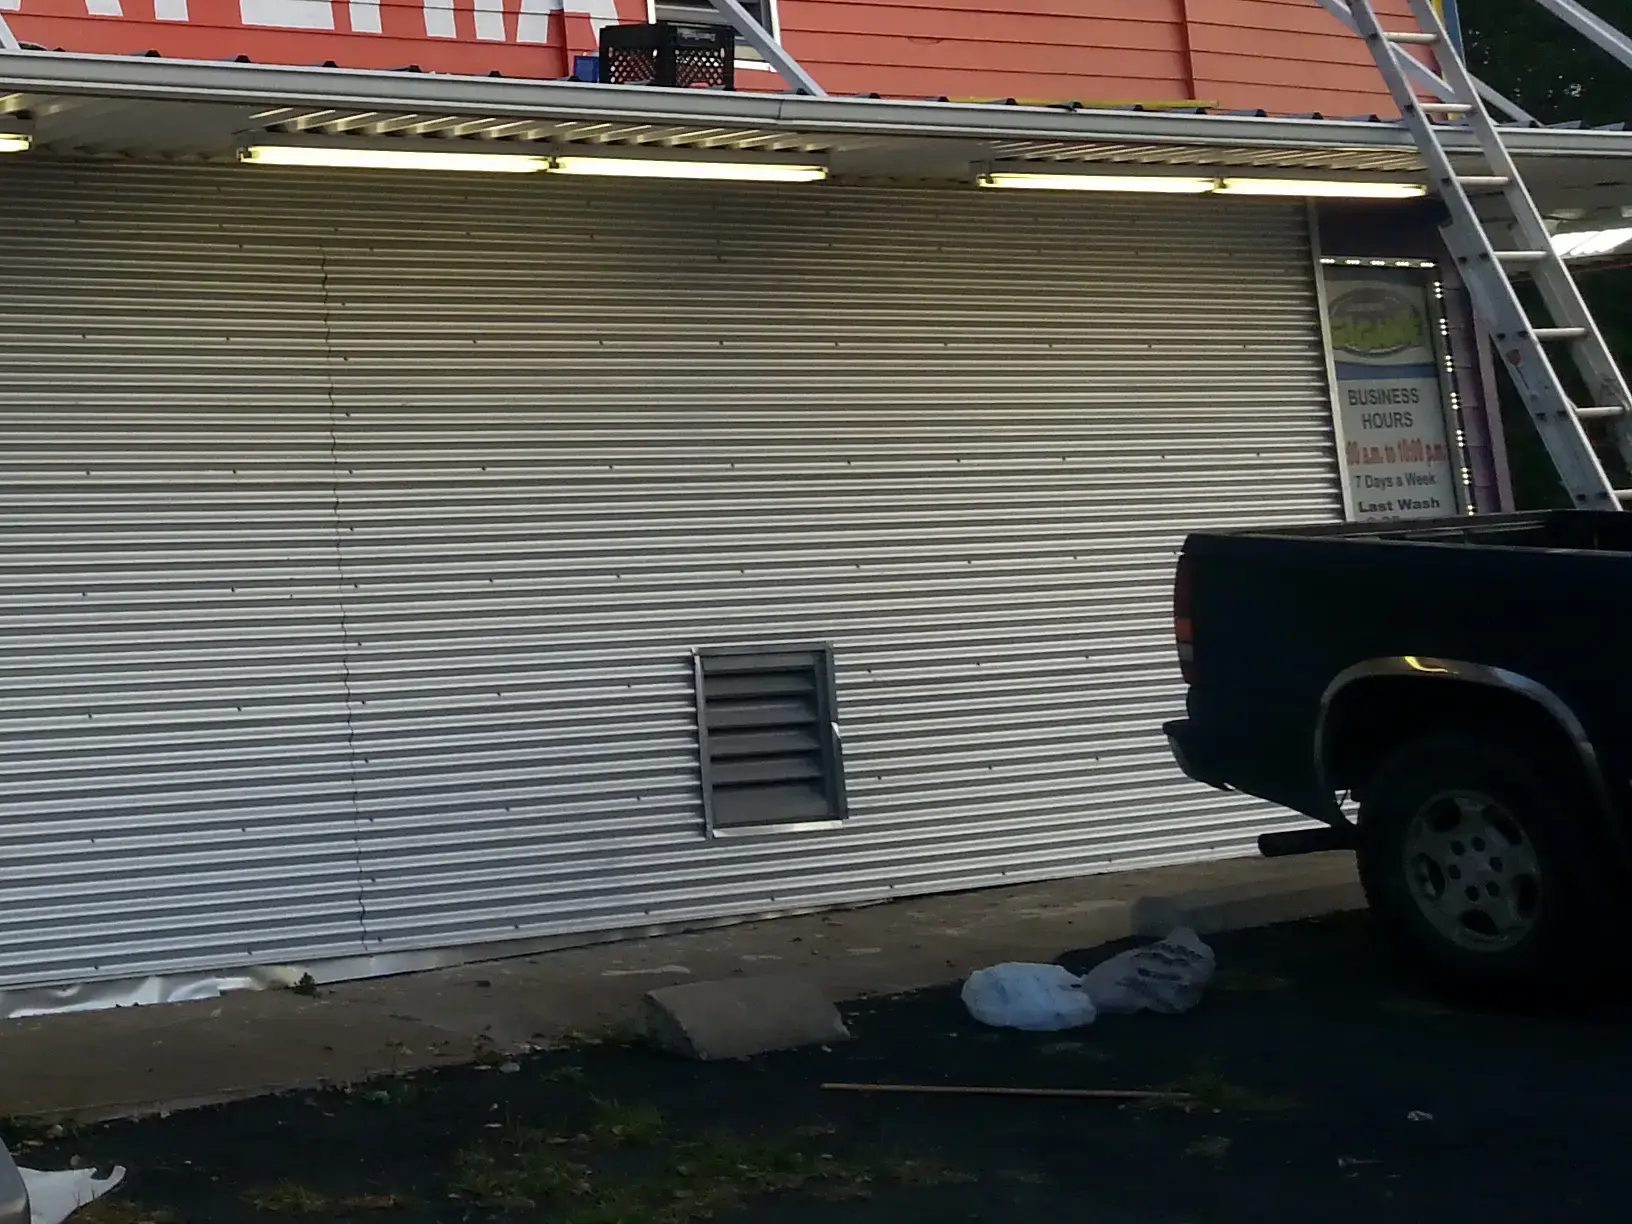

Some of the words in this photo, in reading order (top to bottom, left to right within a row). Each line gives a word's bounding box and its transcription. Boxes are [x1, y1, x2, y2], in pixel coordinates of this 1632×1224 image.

[1348, 388, 1420, 405] BUSINESS
[1362, 412, 1414, 429] HOURS
[1365, 474, 1393, 490] Days
[1404, 473, 1437, 486] Week
[1359, 501, 1394, 513] Last
[1398, 497, 1440, 510] Wash
